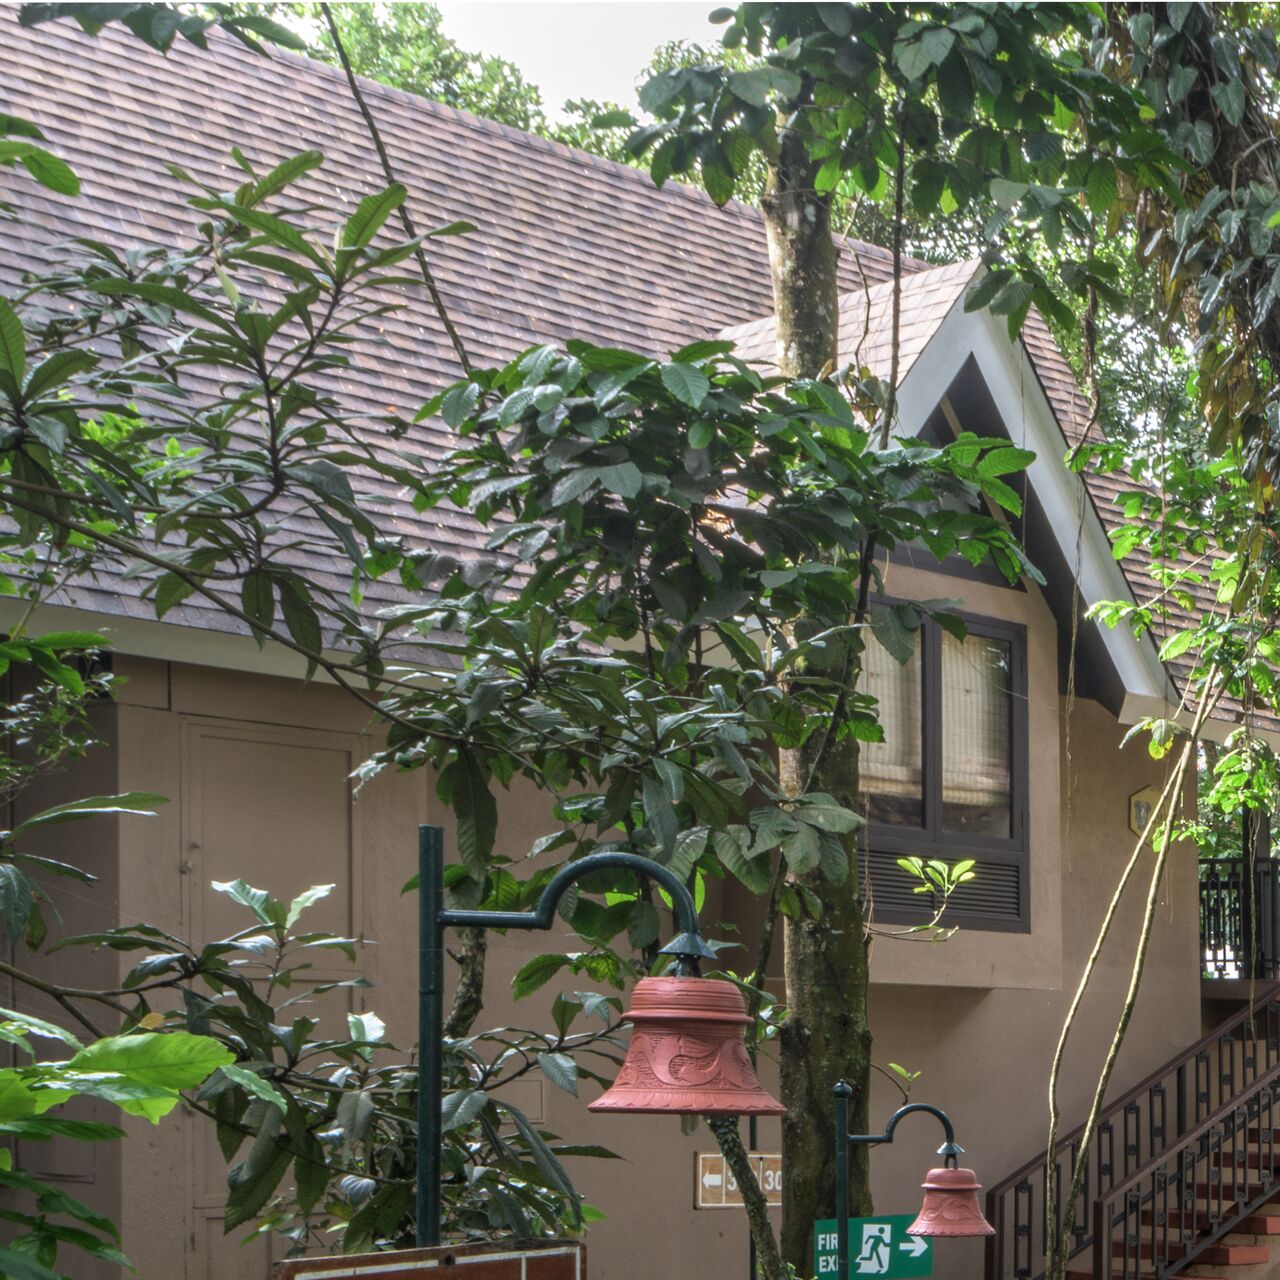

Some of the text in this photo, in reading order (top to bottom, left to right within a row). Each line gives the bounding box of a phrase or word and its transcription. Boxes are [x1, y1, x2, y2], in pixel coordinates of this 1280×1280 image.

[764, 1170, 782, 1190] 30
[818, 1233, 838, 1250] FIR
[819, 1255, 838, 1273] EXI
